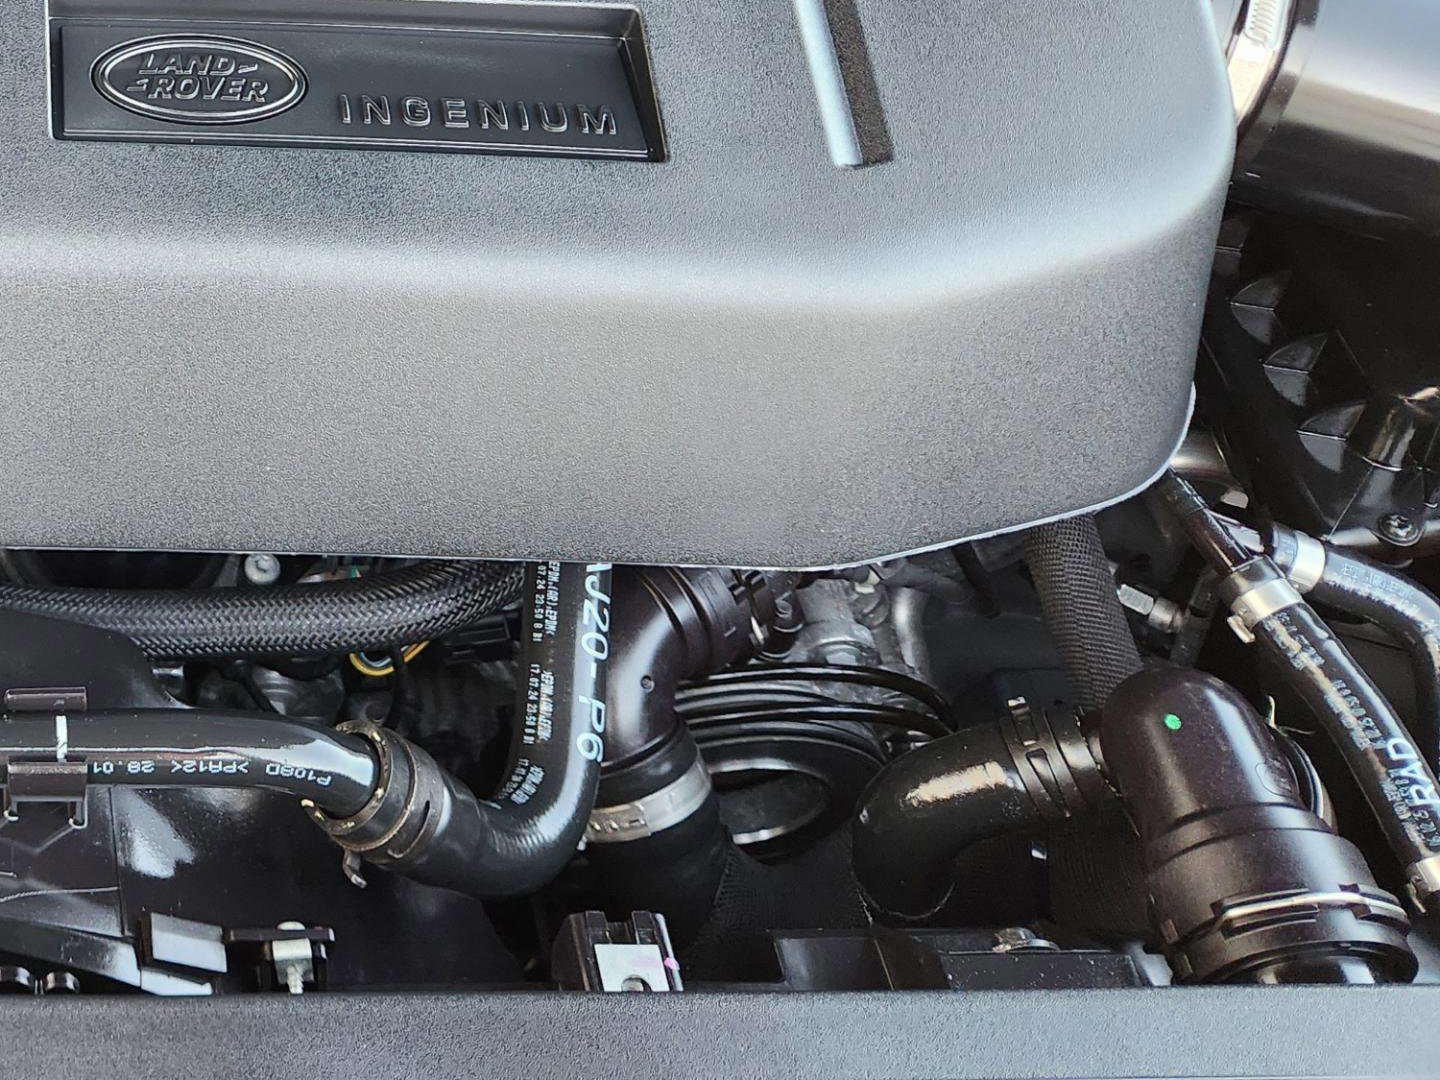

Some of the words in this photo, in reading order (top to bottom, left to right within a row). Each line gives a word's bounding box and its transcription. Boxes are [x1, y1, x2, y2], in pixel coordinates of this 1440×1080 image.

[139, 52, 238, 76] LAND
[148, 77, 269, 103] ROVER
[337, 92, 617, 135] INGENIUM
[576, 695, 607, 763] P6
